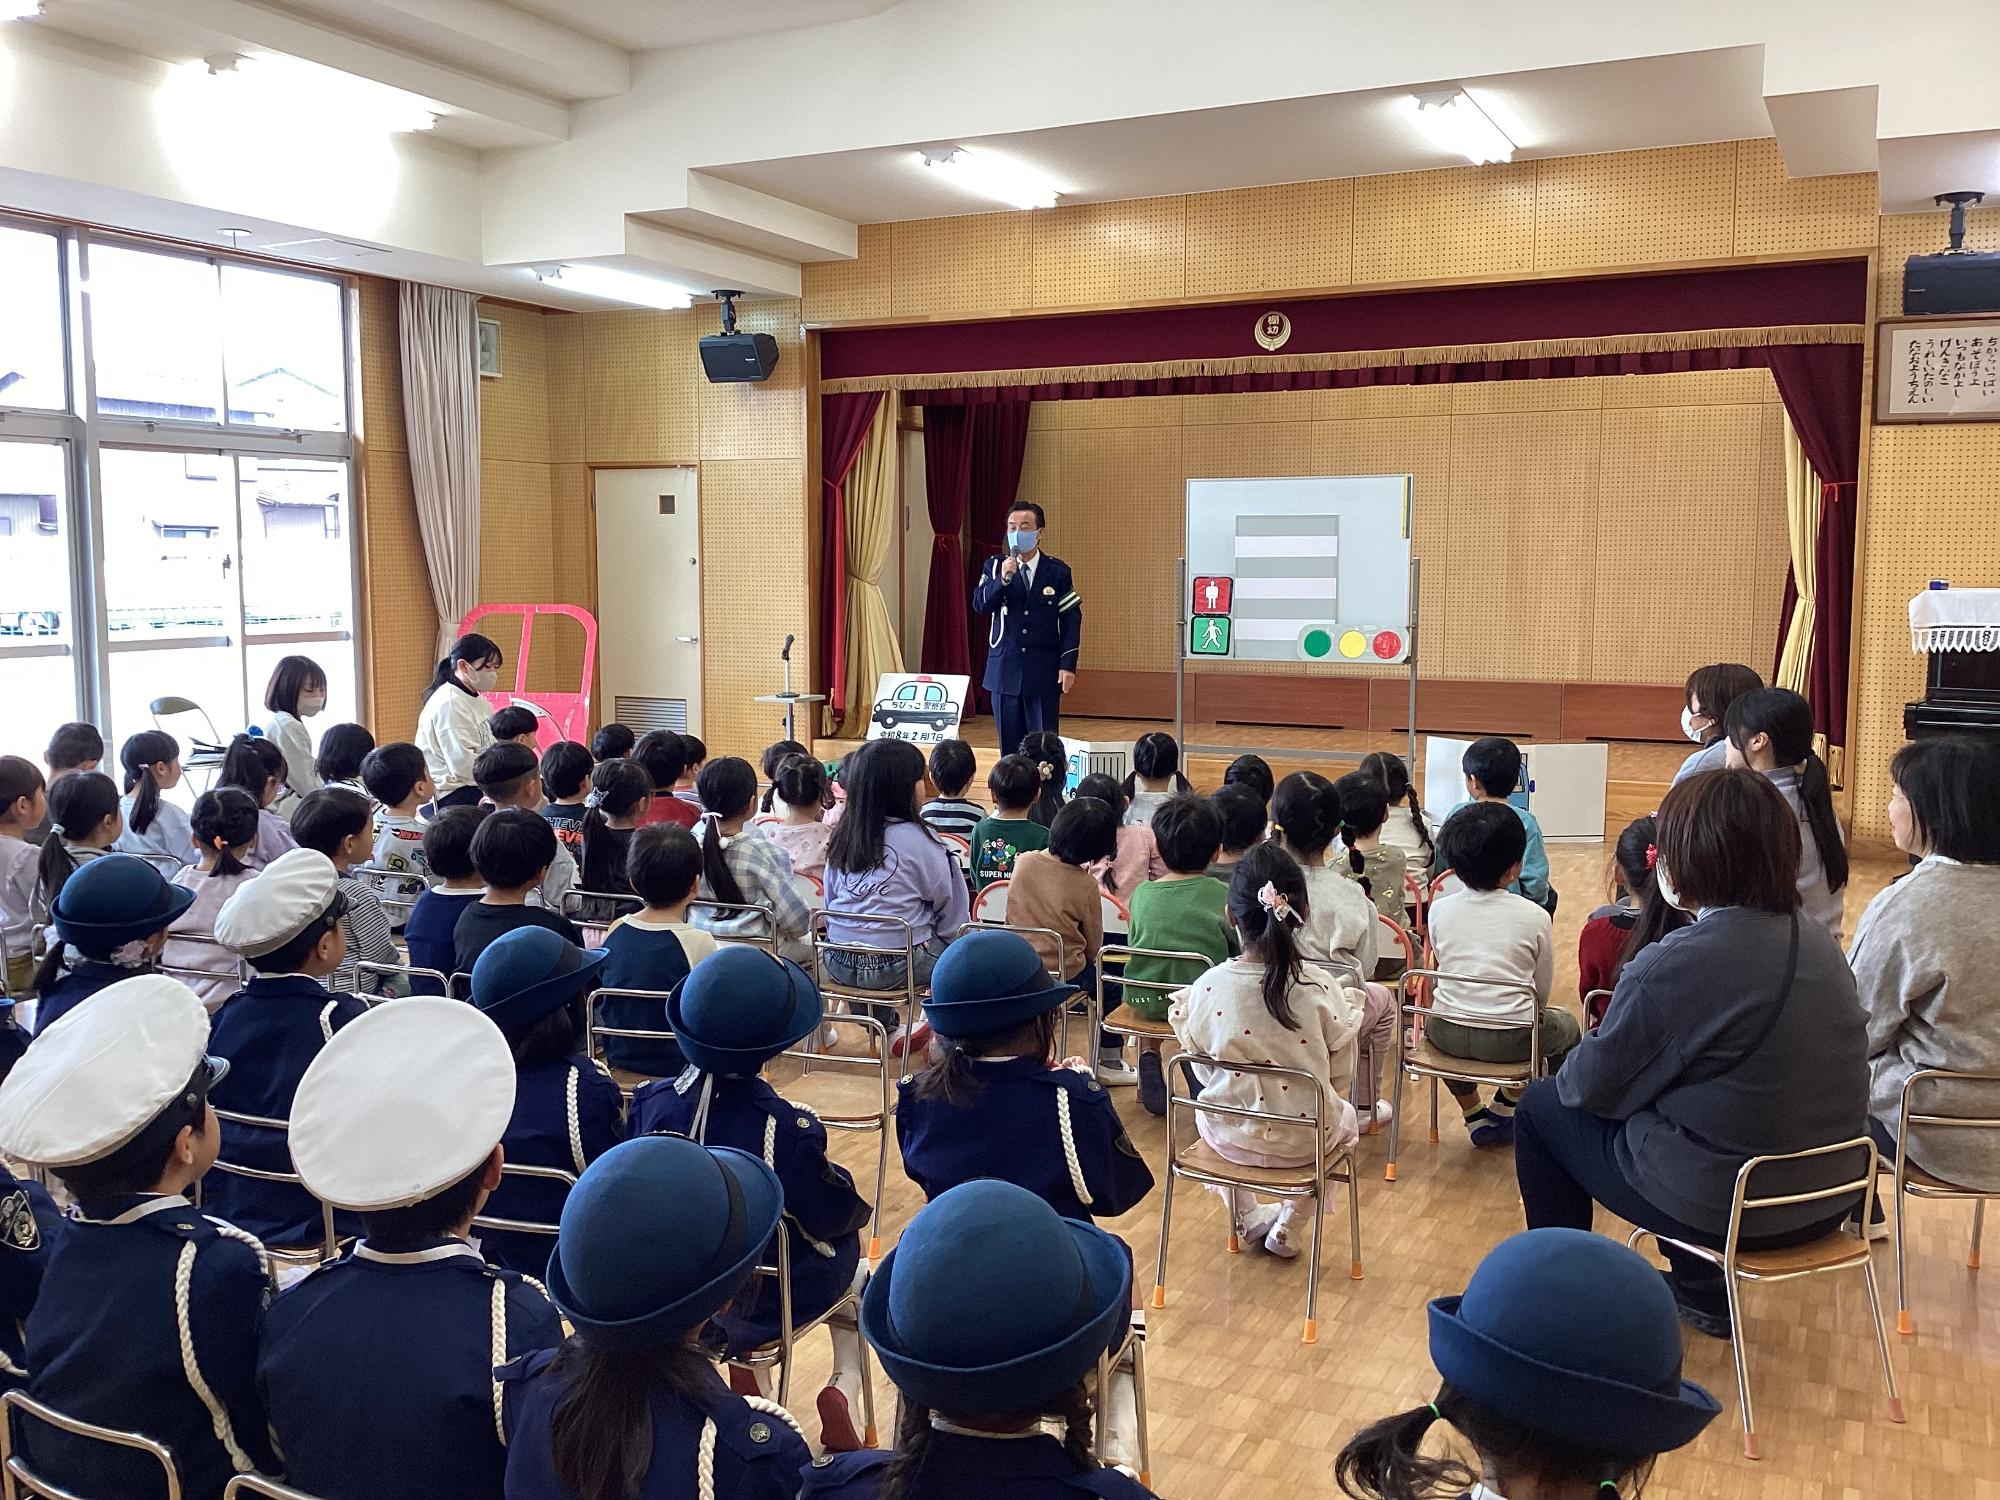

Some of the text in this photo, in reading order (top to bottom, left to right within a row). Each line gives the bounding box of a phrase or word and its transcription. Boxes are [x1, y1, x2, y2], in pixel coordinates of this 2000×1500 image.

[1907, 339, 1921, 404] たなおようちえん
[1922, 338, 1936, 403] うれしいたのしい
[1953, 338, 1968, 398] いつもなかよし
[1969, 337, 1983, 386] あそぼうよ
[979, 870, 1002, 878] SUPER
